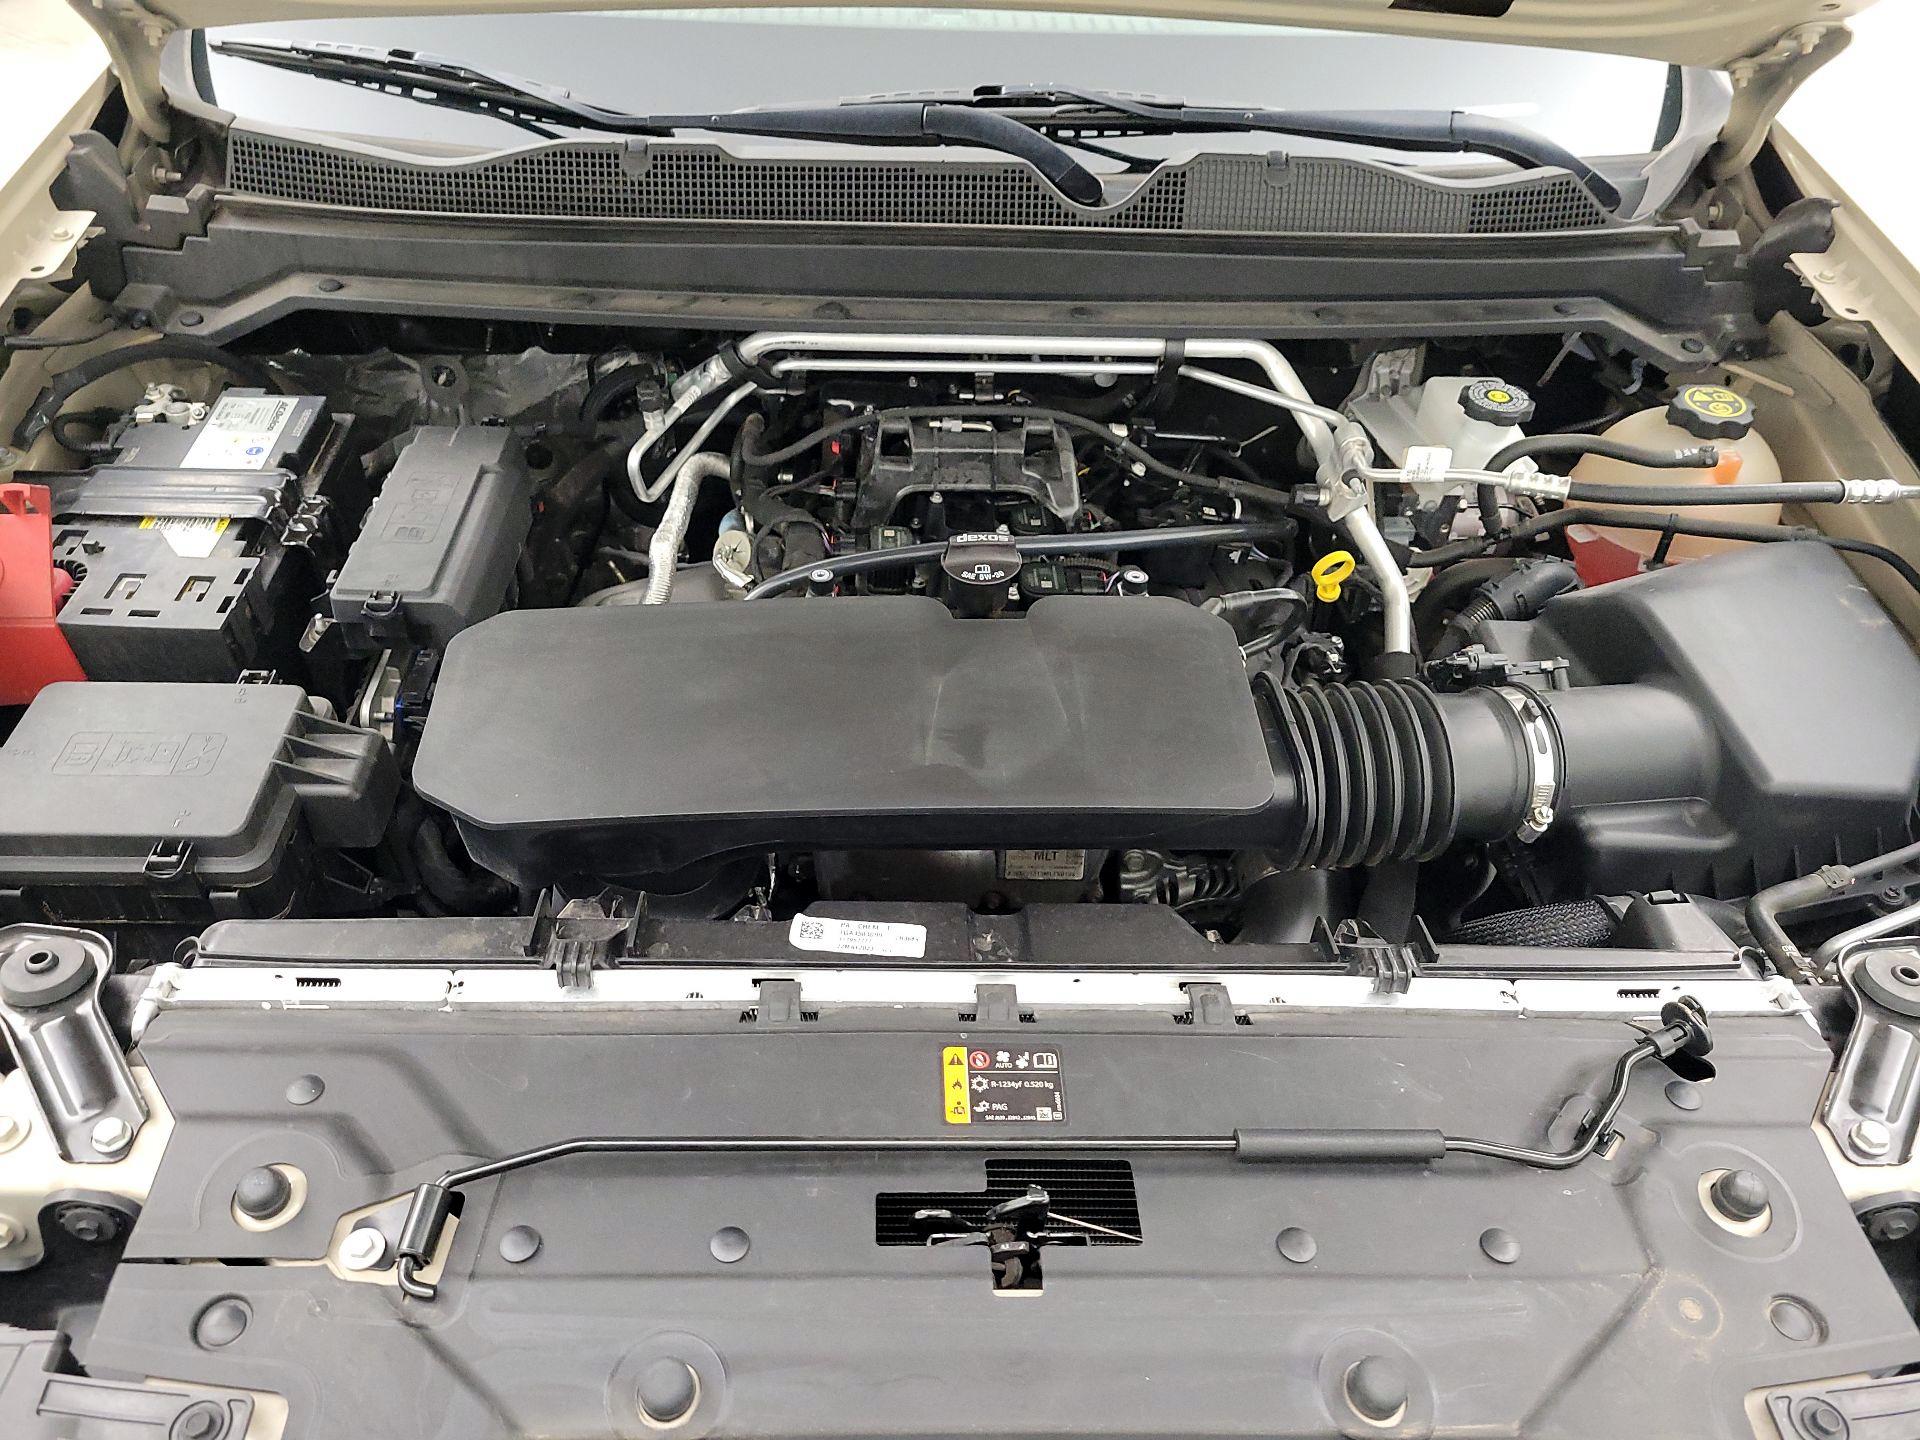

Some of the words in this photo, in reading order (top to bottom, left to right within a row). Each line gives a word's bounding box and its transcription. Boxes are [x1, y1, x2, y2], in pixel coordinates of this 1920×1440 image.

[956, 533, 1009, 543] dexos
[961, 570, 977, 580] SAE
[990, 1081, 1023, 1090] R-1234yf
[1044, 1081, 1054, 1090] kg
[992, 1102, 1008, 1111] PAG
